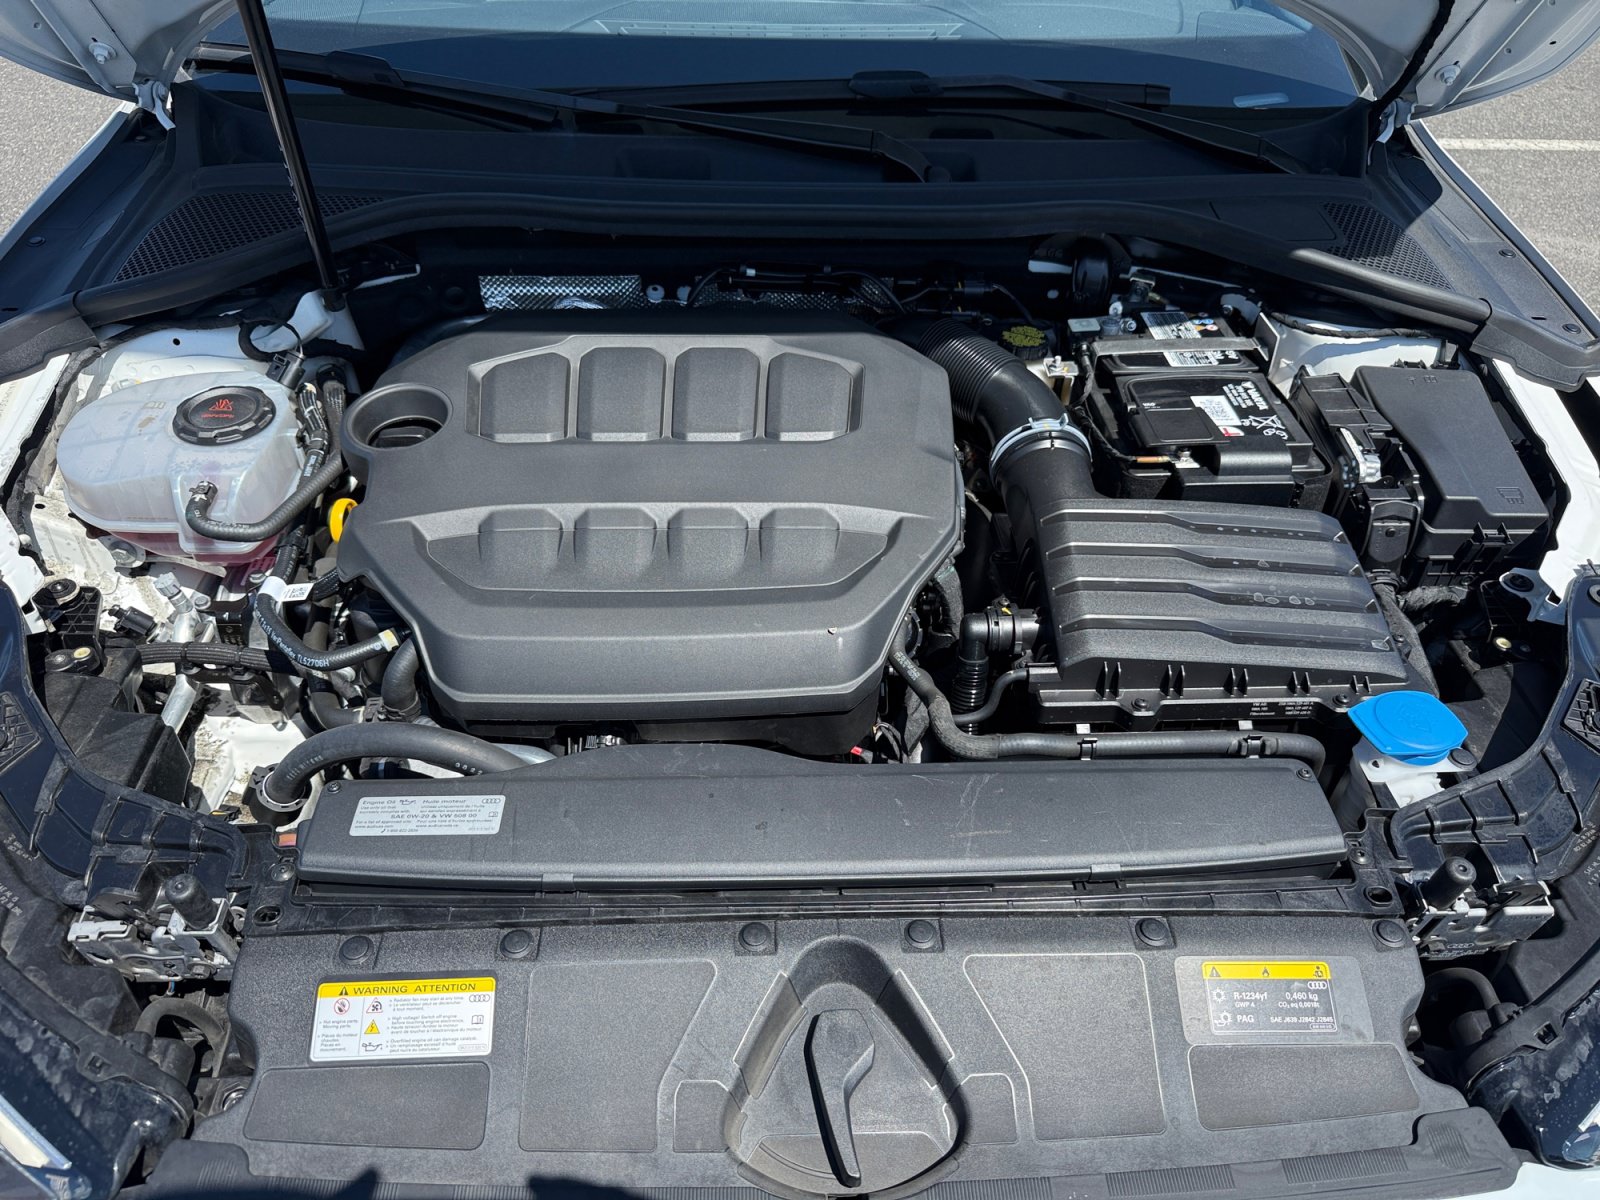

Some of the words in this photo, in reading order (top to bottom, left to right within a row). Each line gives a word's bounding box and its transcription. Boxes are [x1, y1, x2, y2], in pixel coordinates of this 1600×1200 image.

[353, 985, 408, 995] WARNING
[414, 983, 476, 992] ATTENTION
[1234, 992, 1268, 1002] R-1234yf
[1286, 992, 1307, 1001] 0,460
[1308, 992, 1318, 1001] kg
